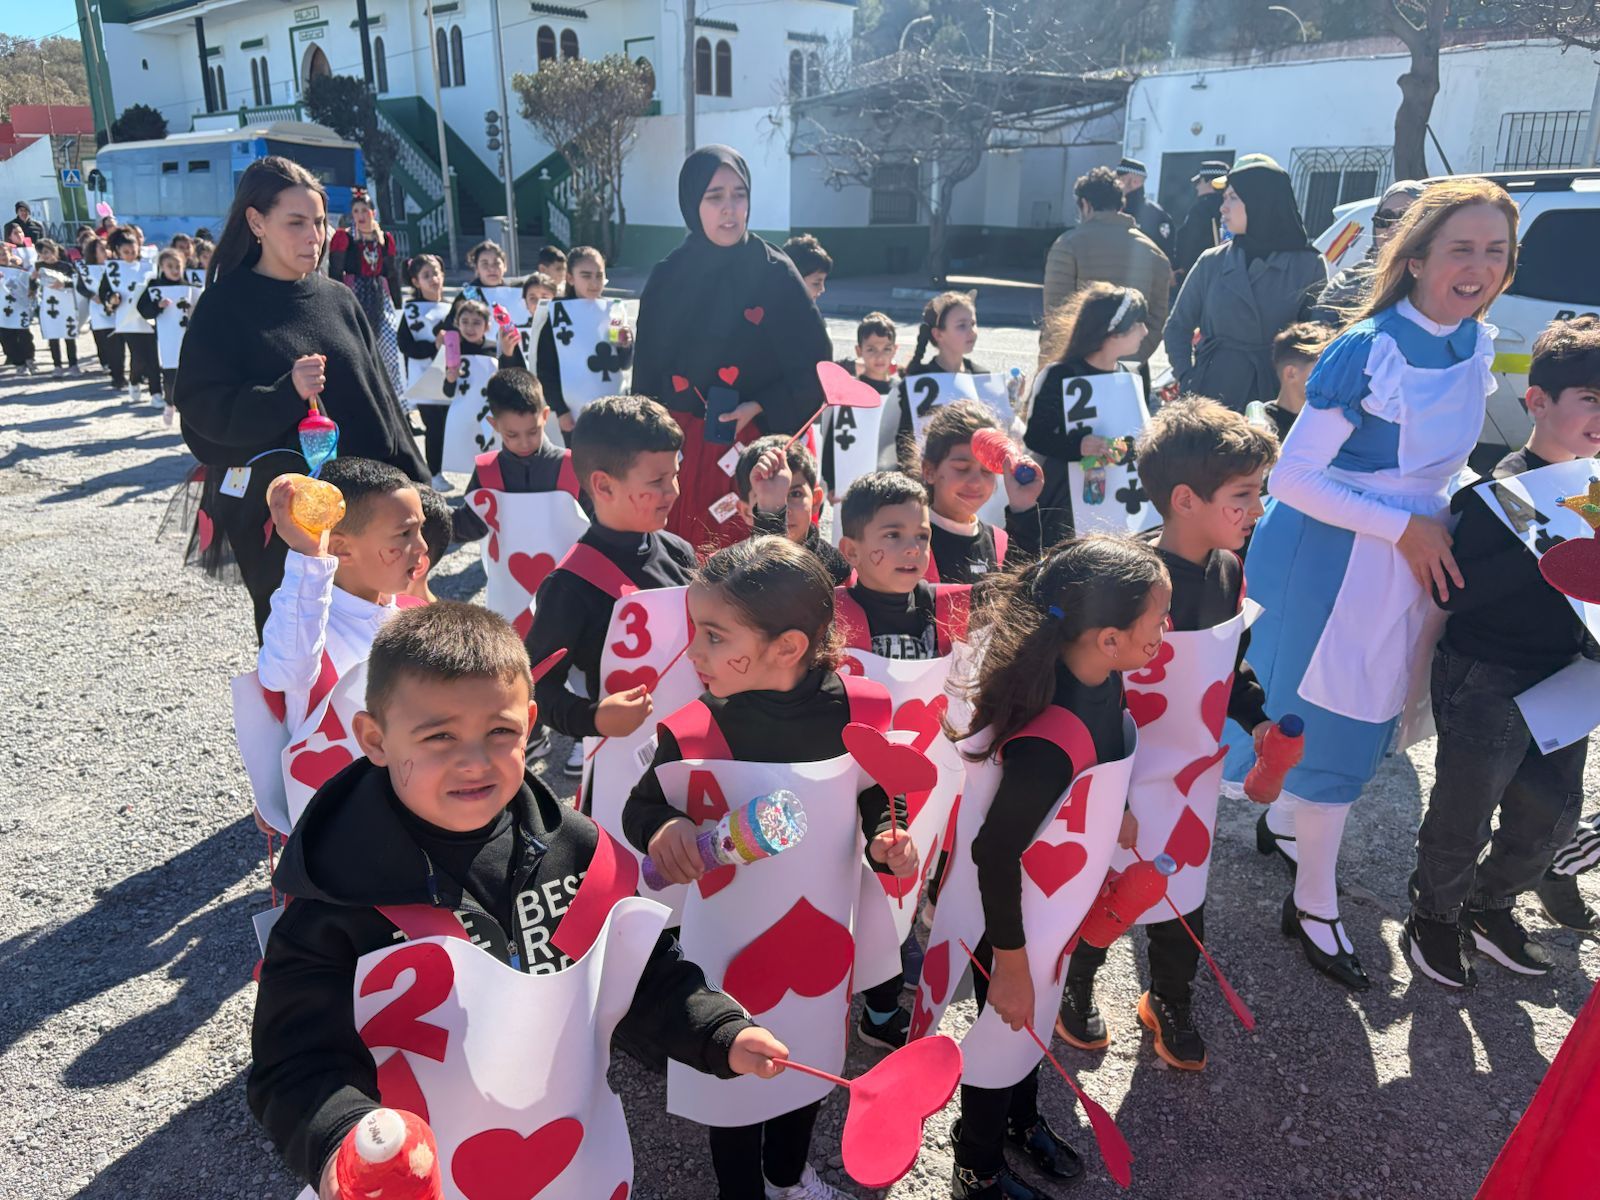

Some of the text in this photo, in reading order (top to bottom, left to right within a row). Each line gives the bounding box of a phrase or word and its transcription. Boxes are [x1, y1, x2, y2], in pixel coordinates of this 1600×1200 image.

[107, 262, 121, 277] 2
[405, 303, 420, 319] 3
[553, 301, 574, 328] A
[459, 357, 470, 378] 3
[834, 405, 858, 430] A
[913, 376, 943, 418] 2
[1066, 378, 1098, 422] 2
[473, 489, 501, 534] 2
[1487, 482, 1551, 534] A
[611, 601, 652, 659] 3
[1127, 640, 1175, 685] 3
[687, 769, 730, 827] A
[359, 942, 455, 1064] 2
